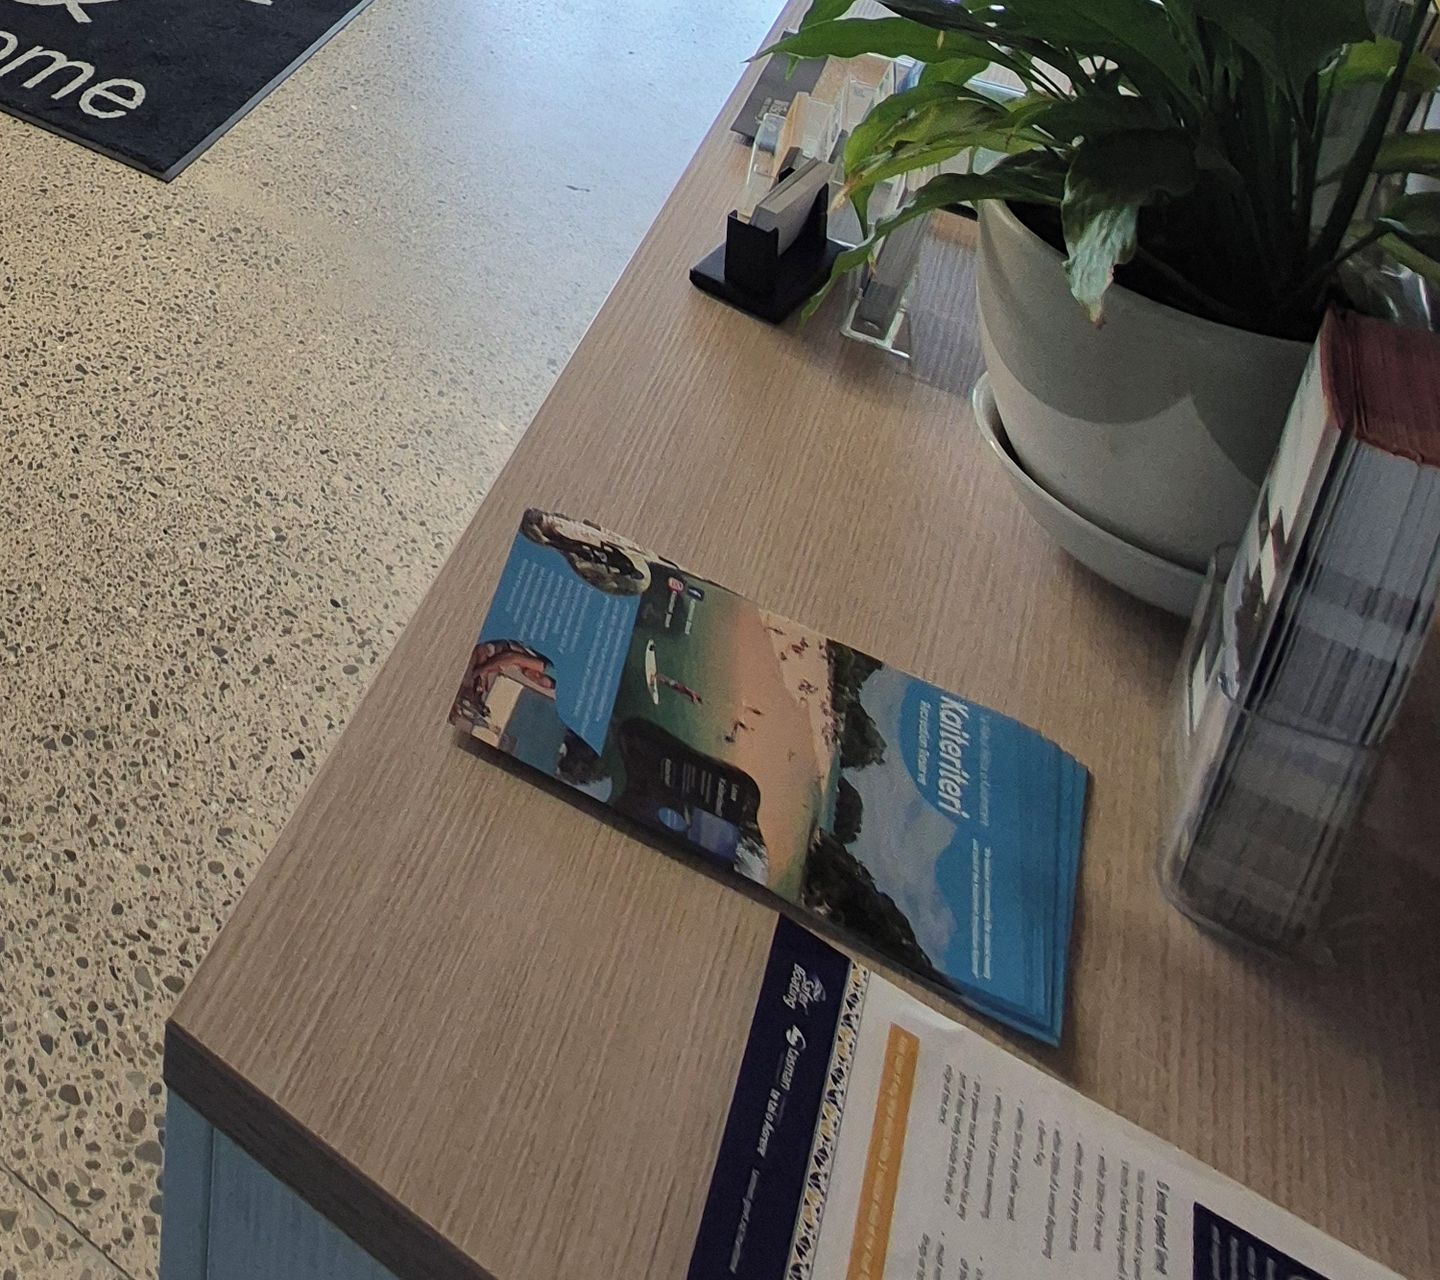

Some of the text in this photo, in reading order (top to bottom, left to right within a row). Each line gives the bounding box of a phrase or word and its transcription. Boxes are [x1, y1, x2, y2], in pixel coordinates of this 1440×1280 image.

[938, 695, 970, 819] Kaiteriteri
[782, 963, 806, 1010] Boating
[779, 1047, 800, 1091] tasman
